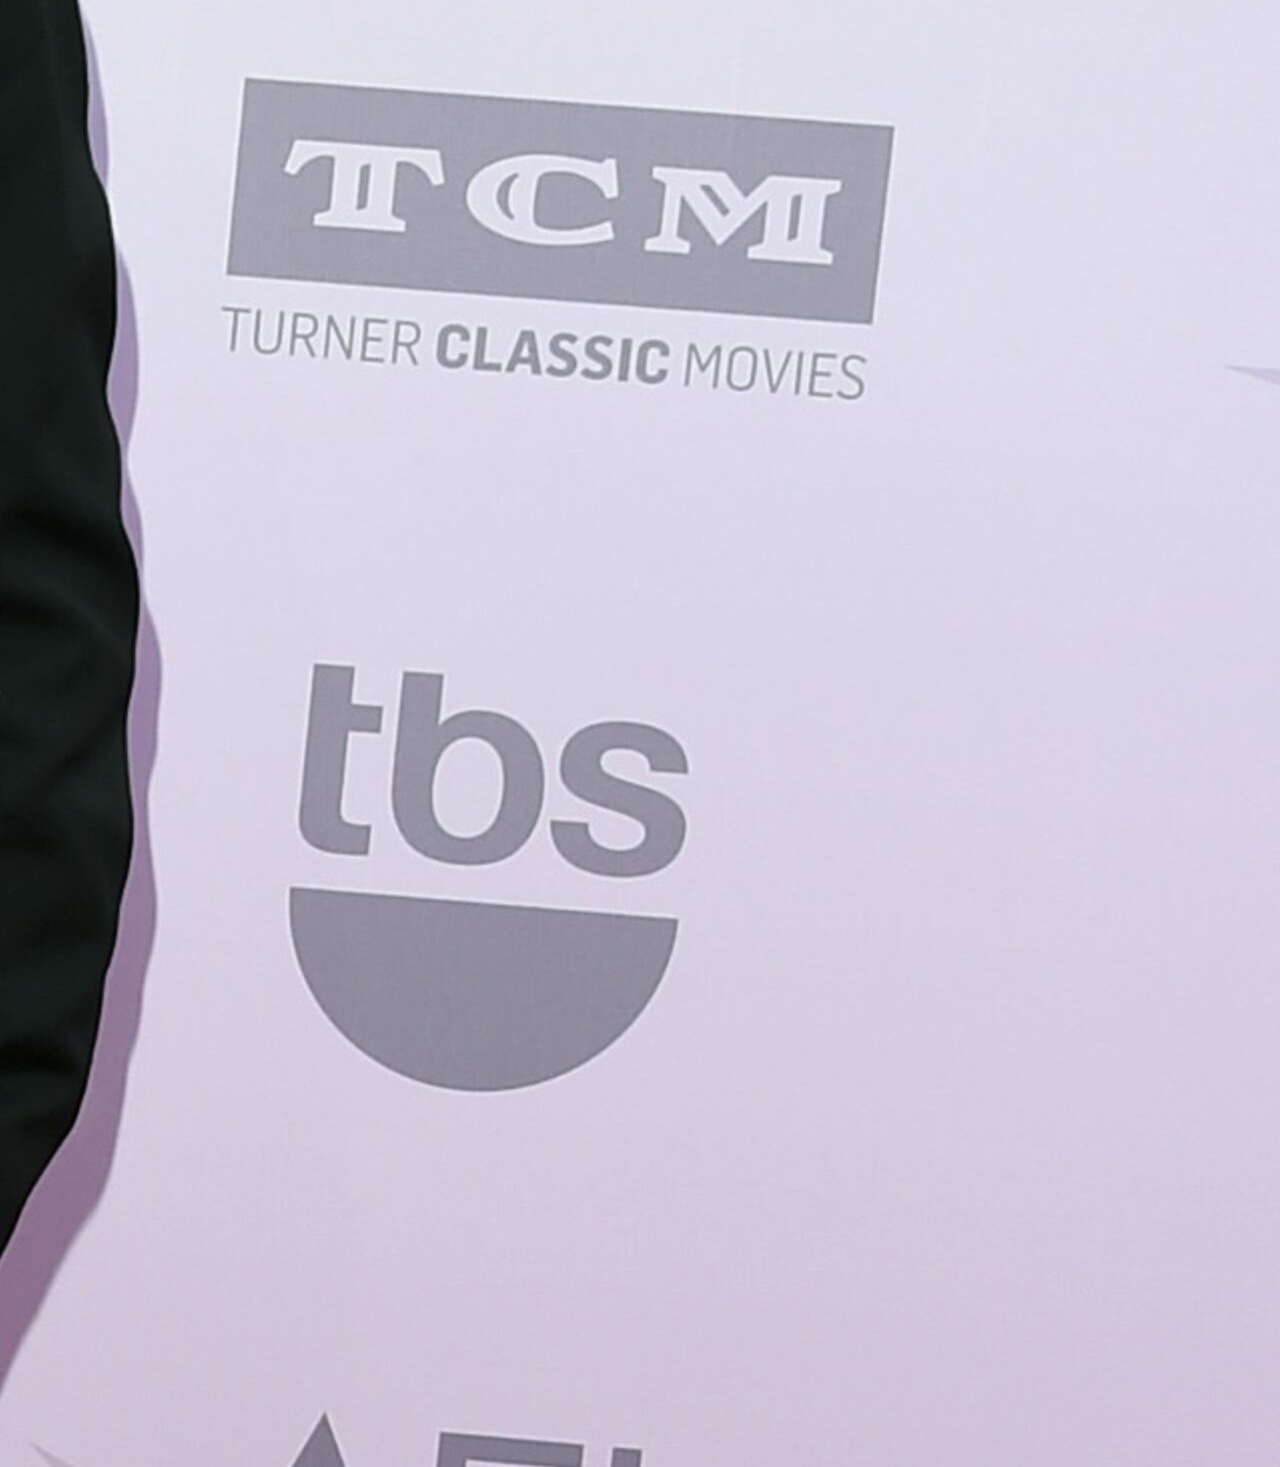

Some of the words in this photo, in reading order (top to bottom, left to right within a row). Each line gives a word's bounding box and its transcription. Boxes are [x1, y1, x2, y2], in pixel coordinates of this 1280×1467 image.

[283, 139, 842, 265] TCM
[220, 305, 422, 367] TURNER
[436, 323, 671, 385] CLASSIC
[683, 341, 868, 401] MOVIES
[298, 663, 689, 878] tbs
